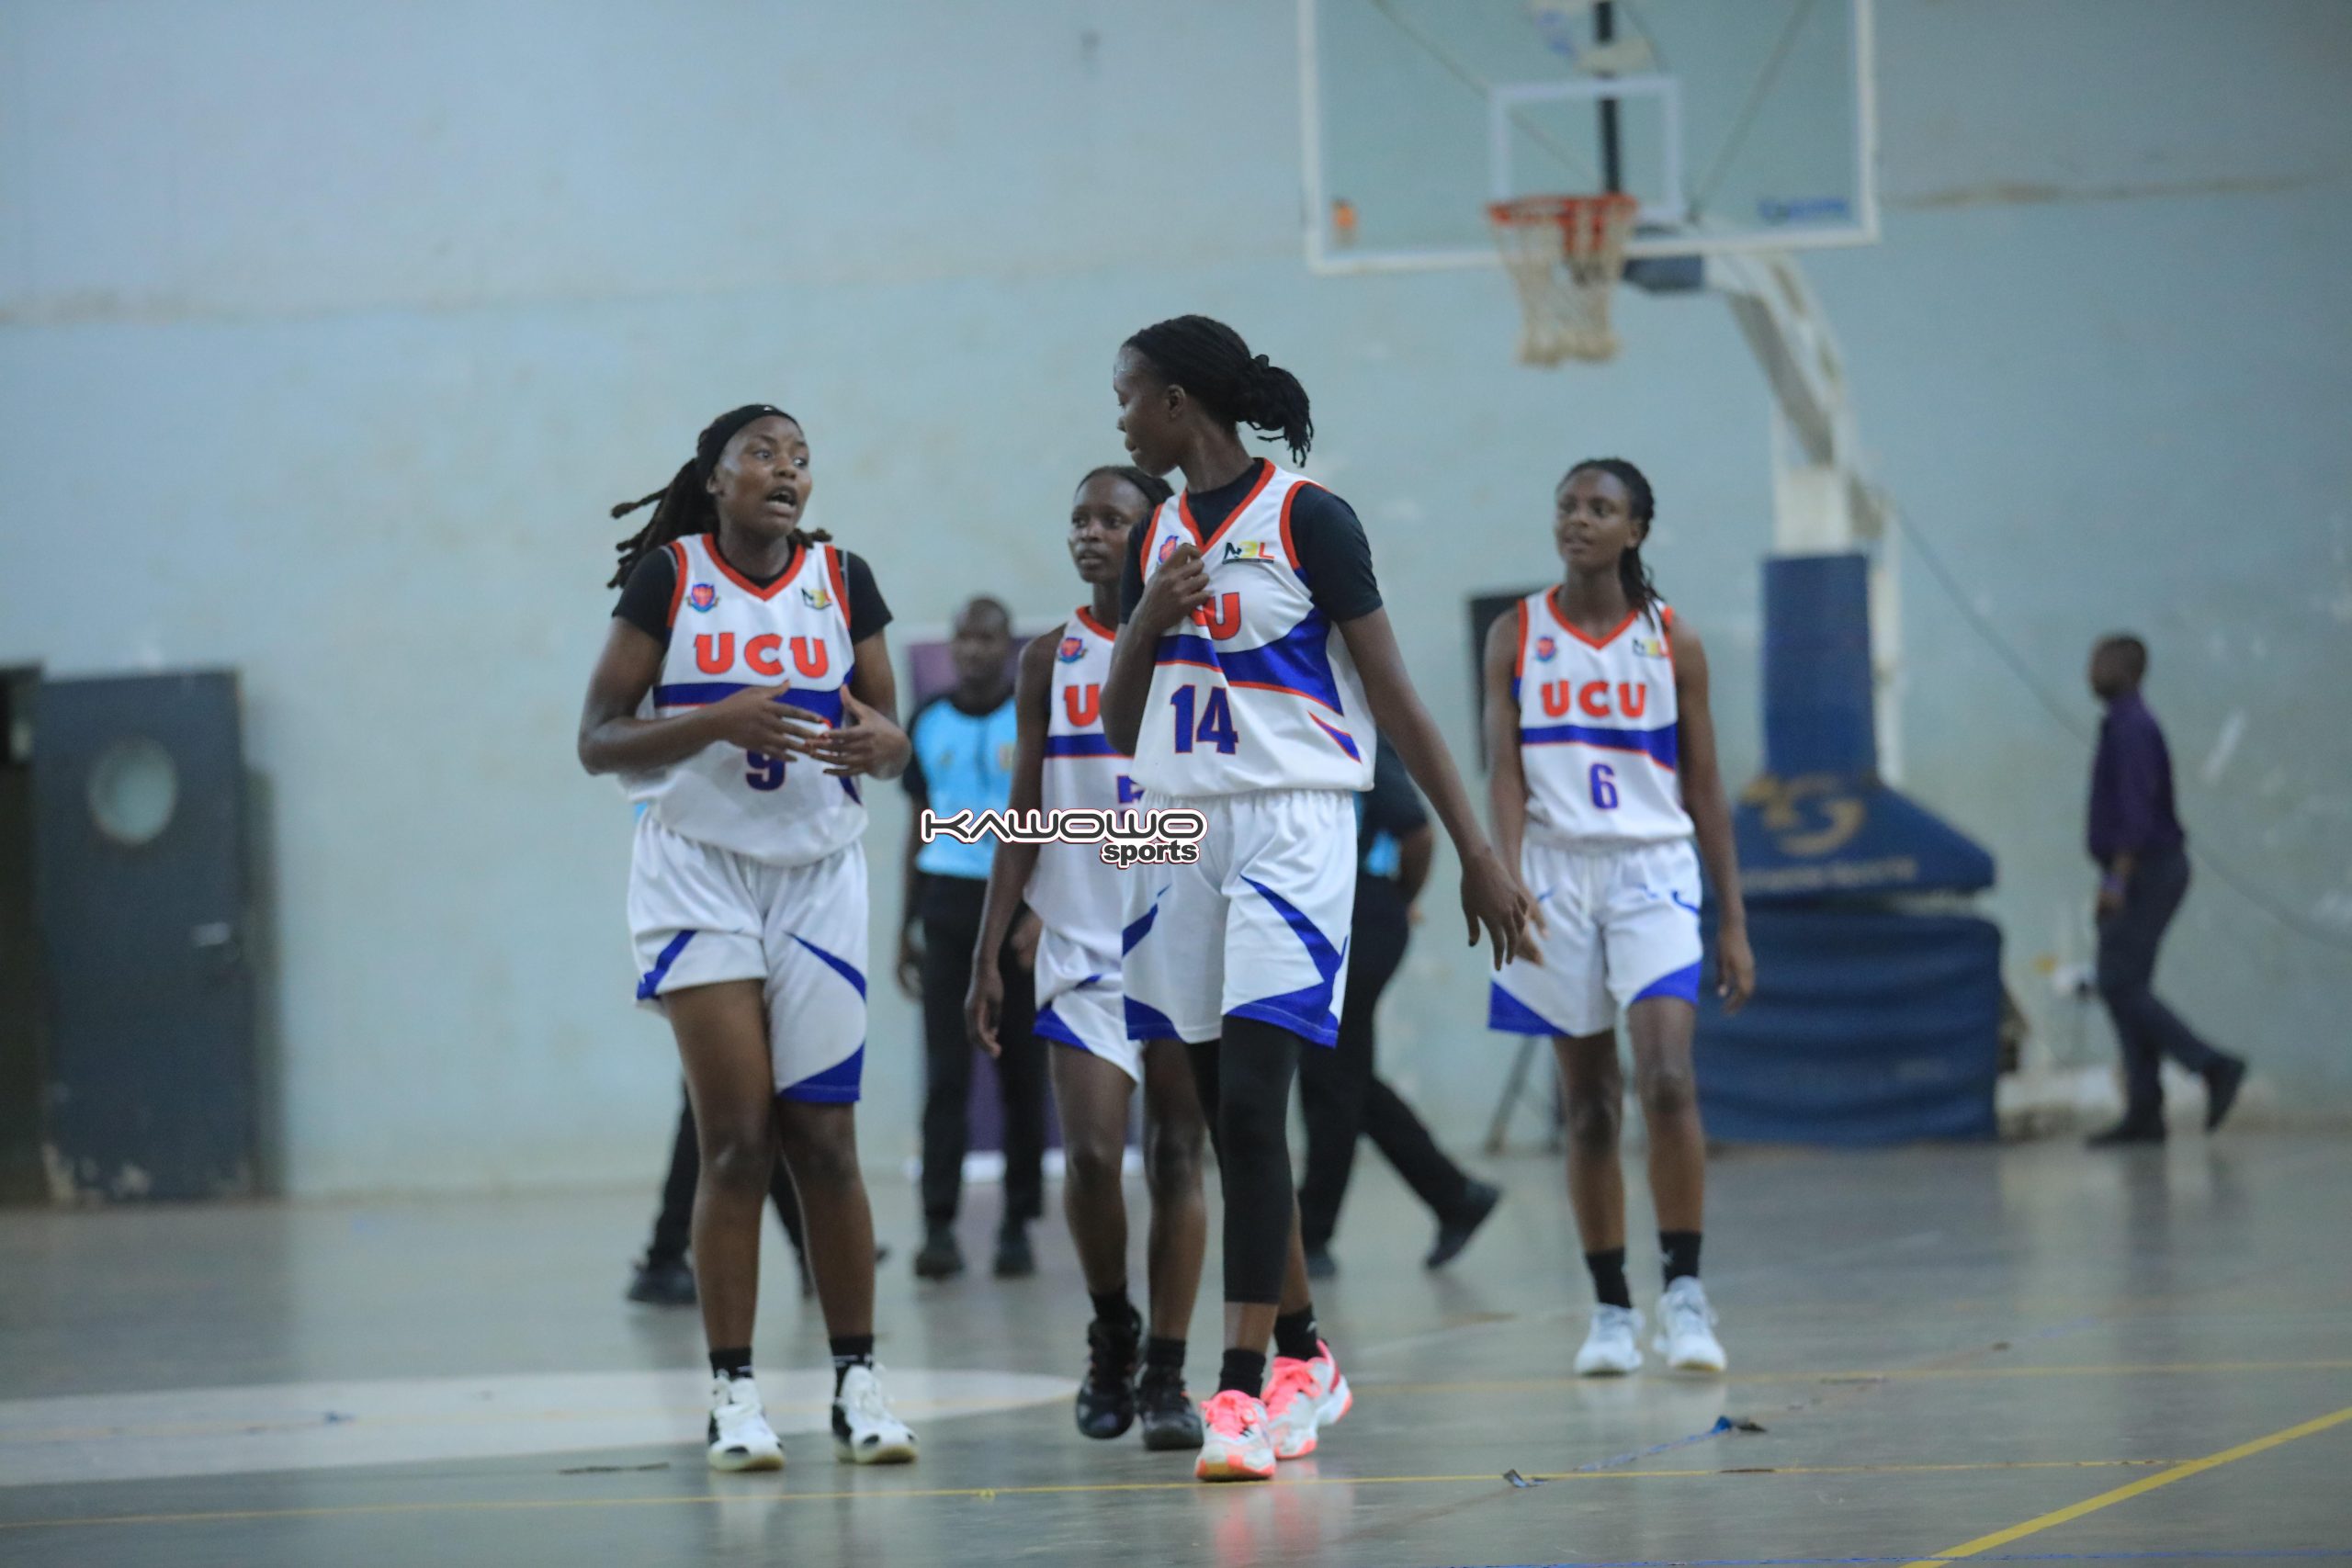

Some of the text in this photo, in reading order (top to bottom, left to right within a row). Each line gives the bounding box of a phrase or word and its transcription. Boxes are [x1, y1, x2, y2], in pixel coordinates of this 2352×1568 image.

[694, 632, 830, 679] UCU
[1170, 683, 1238, 755] 14
[1541, 680, 1647, 718] UCU
[746, 750, 786, 791] 9
[1589, 762, 1619, 809] 6
